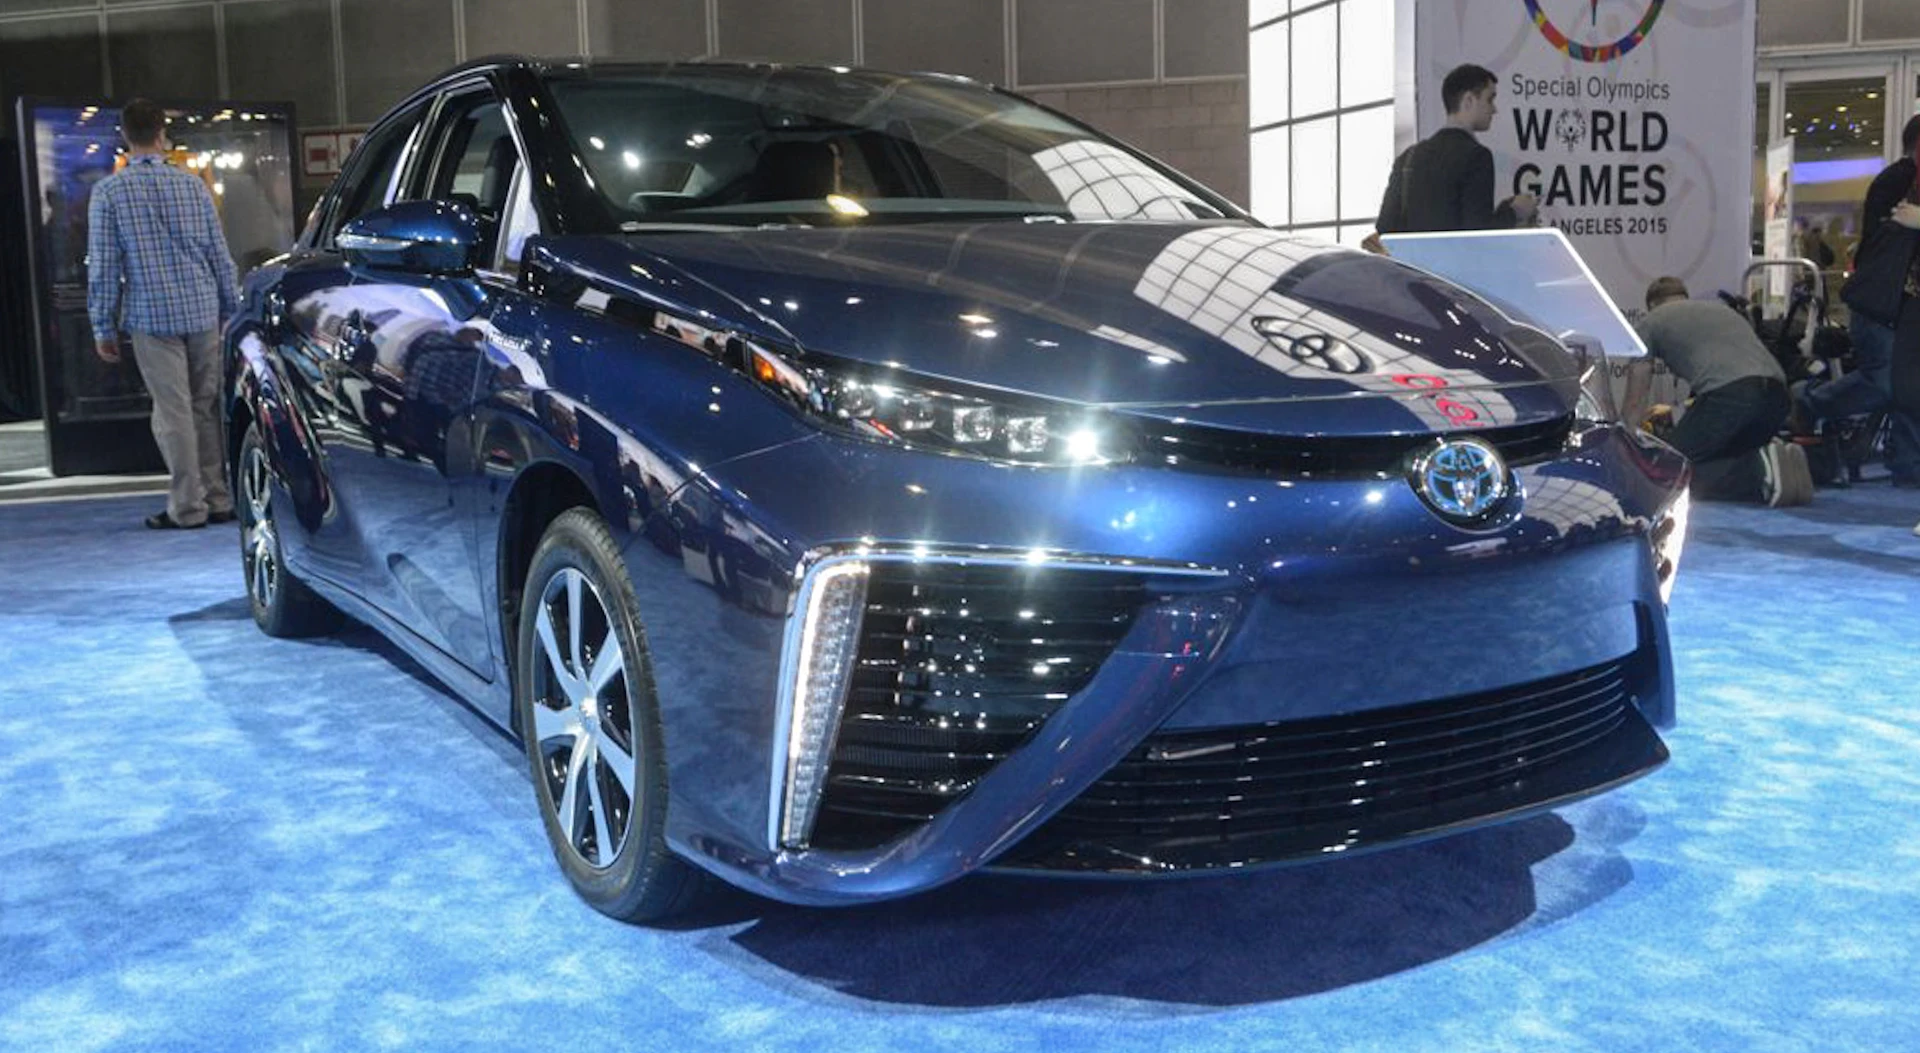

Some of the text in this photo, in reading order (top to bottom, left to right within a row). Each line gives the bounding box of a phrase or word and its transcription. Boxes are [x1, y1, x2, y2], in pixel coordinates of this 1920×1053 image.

[1511, 73, 1671, 103] Special Olympics
[1513, 162, 1668, 207] GAMES
[1628, 218, 1668, 234] 2015
